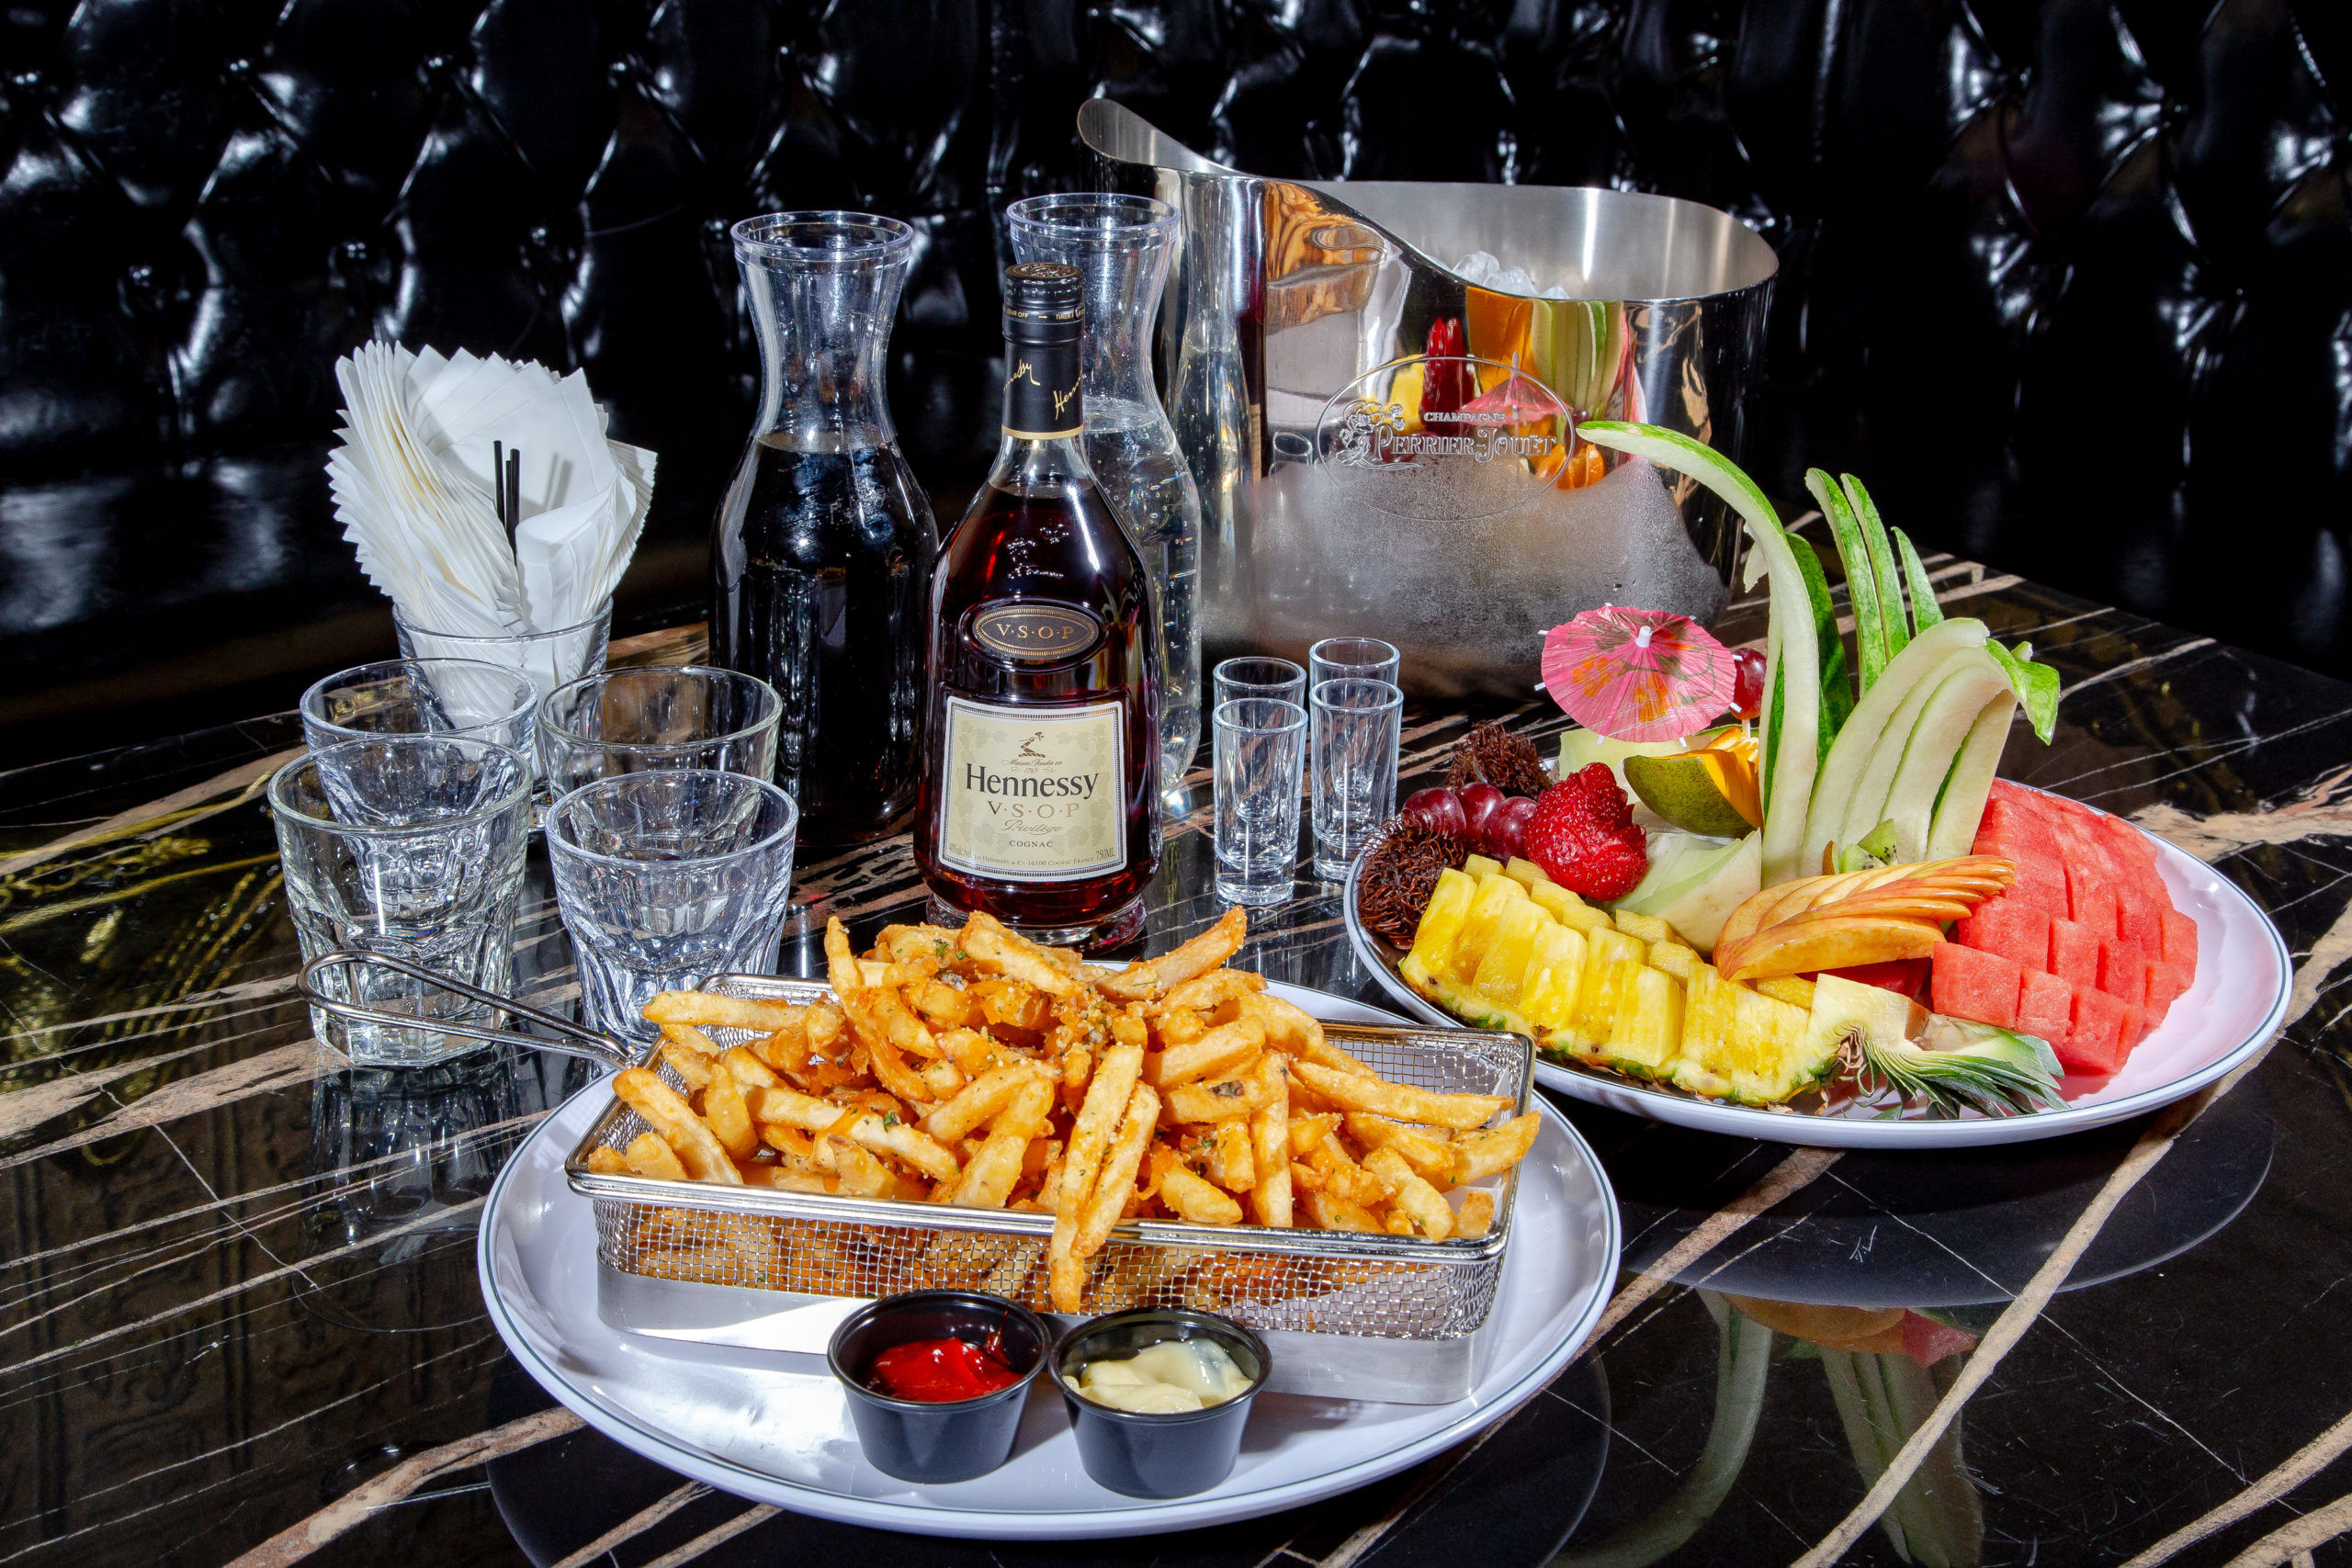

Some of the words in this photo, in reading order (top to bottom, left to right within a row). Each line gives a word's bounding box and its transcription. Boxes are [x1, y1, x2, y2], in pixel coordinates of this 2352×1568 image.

[1423, 412, 1507, 423] CHAMPAGNE
[966, 762, 1099, 800] Hennessy
[1009, 840, 1054, 848] COGNAC
[1073, 855, 1094, 864] FRANCE
